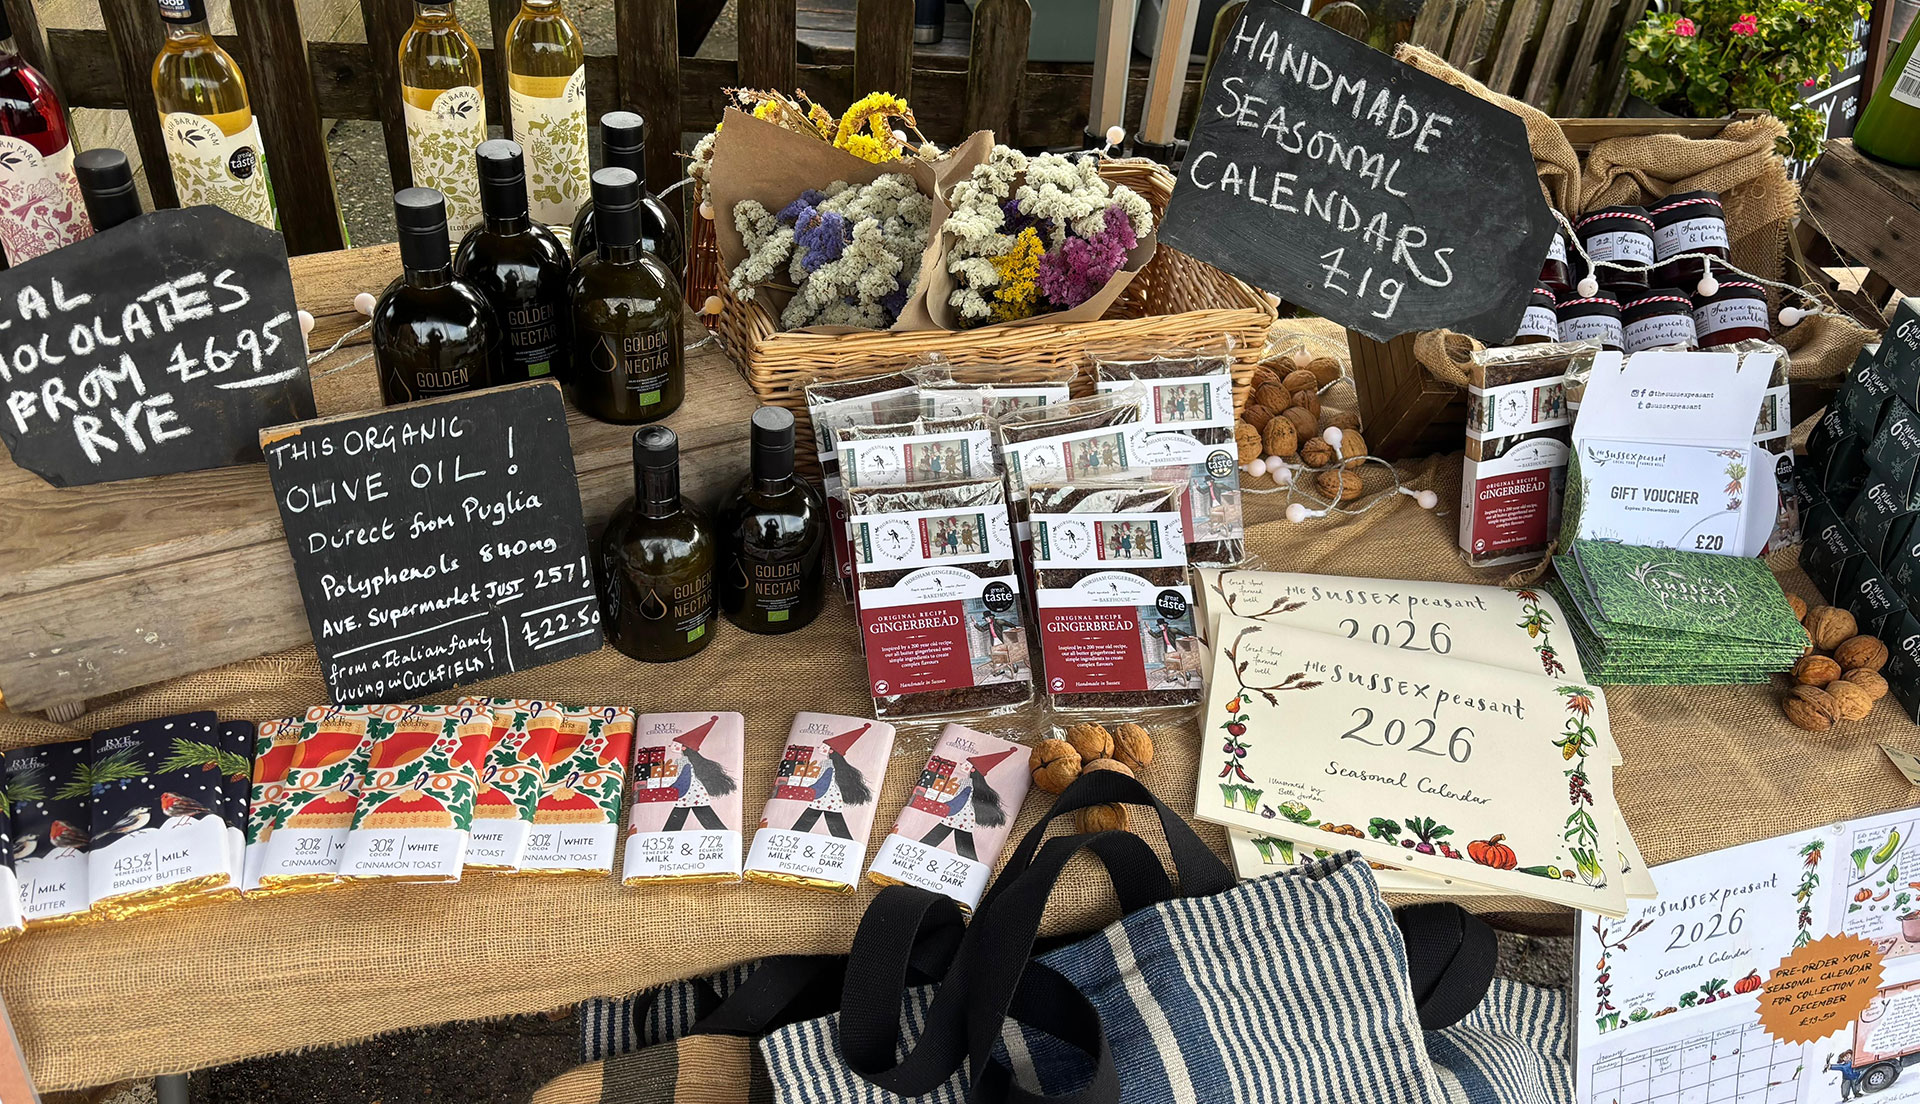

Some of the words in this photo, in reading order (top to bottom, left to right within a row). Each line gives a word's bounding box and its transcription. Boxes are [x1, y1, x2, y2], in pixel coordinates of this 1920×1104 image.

[1231, 15, 1454, 153] HANDMADE
[448, 92, 469, 102] BARN
[174, 118, 199, 127] BARN
[201, 125, 220, 146] FARM
[1215, 77, 1408, 198] SEASONAL
[16, 145, 38, 168] FARM
[1190, 151, 1455, 288] CALENDARS
[1688, 232, 1696, 243] &
[1319, 246, 1406, 321] £19
[510, 325, 557, 347] NECTAR
[623, 331, 669, 353] GOLDEN
[624, 352, 670, 375] NECTAR
[416, 368, 470, 388] GOLDEN
[1857, 366, 1871, 384] 6
[1871, 371, 1890, 395] Mince
[1863, 380, 1877, 396] Pies
[72, 391, 194, 465] RYE
[1890, 418, 1908, 437] 6
[270, 436, 334, 470] THIS
[343, 415, 465, 456] ORGANIC
[1897, 434, 1911, 451] Pies
[1206, 458, 1233, 471] taste
[285, 472, 389, 513] OLIVE
[410, 454, 486, 489] OIL
[1479, 481, 1546, 501] GINGERBREAD
[1486, 479, 1515, 490] ORIGINAL
[1516, 476, 1539, 486] RECIPE
[1610, 486, 1639, 500] GIFT
[1643, 488, 1699, 505] VOUCHER
[1867, 482, 1886, 501] 6
[1880, 487, 1898, 514] Mince
[307, 517, 395, 554] Direct
[461, 491, 543, 526] Puglia
[1694, 534, 1724, 551] £20
[320, 553, 460, 601] Polyphenols
[479, 535, 557, 562] 840mg
[755, 561, 800, 578] GOLDEN
[674, 569, 712, 600] GOLDEN
[755, 579, 801, 596] NECTAR
[990, 587, 1005, 595] great
[1860, 577, 1878, 594] 6
[1873, 583, 1891, 610] Mince
[674, 588, 713, 619] NECTAR
[984, 591, 1013, 602] taste
[1158, 598, 1185, 611] taste
[1164, 594, 1180, 602] great
[322, 616, 362, 639] AVE.
[367, 588, 481, 630] Supermarket
[485, 577, 525, 599] JUST
[877, 612, 917, 622] ORIGINAL
[919, 609, 948, 618] RECIPE
[1407, 595, 1488, 620] peasant
[521, 608, 601, 647] £22.50
[869, 615, 959, 635] GINGERBREAD
[1047, 620, 1134, 633] GINGERBREAD
[329, 660, 367, 686] from
[371, 661, 381, 670] a
[382, 644, 448, 668] Italian
[446, 627, 493, 658] family
[1254, 667, 1272, 676] well
[335, 679, 385, 703] living
[388, 671, 402, 688] in
[1432, 689, 1527, 721] peasant
[654, 723, 677, 731] RYE
[1340, 707, 1476, 764] 2026
[105, 735, 132, 747] RYE
[12, 756, 39, 768] RYE
[1324, 760, 1409, 789] Seasonal
[1416, 776, 1493, 806] Calendar
[295, 837, 322, 851] 30%
[368, 838, 395, 853] 30%
[407, 842, 440, 852] WHITE
[473, 832, 503, 841] WHITE
[527, 833, 552, 848] 30%
[563, 836, 595, 846] WHITE
[680, 843, 694, 857] &
[699, 835, 724, 849] 72%
[162, 848, 190, 863] MILK
[477, 848, 505, 857] TOAST
[570, 853, 598, 862] TOAST
[645, 854, 670, 863] MILK
[698, 852, 724, 861] DARK
[802, 846, 816, 859] &
[822, 841, 847, 858] 72%
[281, 858, 338, 867] CINNAMON
[355, 860, 410, 870] CINNAMON
[412, 860, 442, 870] TOAST
[659, 862, 706, 871] PISTACHIO
[768, 851, 792, 861] MILK
[818, 857, 844, 870] DARK
[778, 861, 824, 875] PISTACHIO
[926, 859, 940, 873] &
[947, 858, 972, 876] 72%
[113, 873, 153, 889] BRANDY
[156, 865, 193, 881] BUTTER
[114, 867, 153, 877] VENEZUELA
[891, 858, 915, 871] MILK
[939, 874, 965, 888] DARK
[900, 871, 944, 891] PISTACHIO
[38, 882, 67, 894] MILK
[1720, 872, 1779, 913] peasant
[28, 899, 66, 913] BUTTER
[1664, 907, 1747, 953] 2026
[1655, 955, 1704, 981] Seasonal
[1708, 947, 1753, 966] Calendar
[1775, 957, 1840, 979] PRE-ORDER
[1842, 949, 1872, 964] YOUR
[1765, 976, 1816, 994] SEASONAL
[1820, 962, 1874, 981] CALENDAR
[1771, 994, 1793, 1007] FOR
[1796, 981, 1854, 1001] COLLECTION
[1857, 976, 1870, 986] IN
[1789, 993, 1848, 1016] DECEMBER
